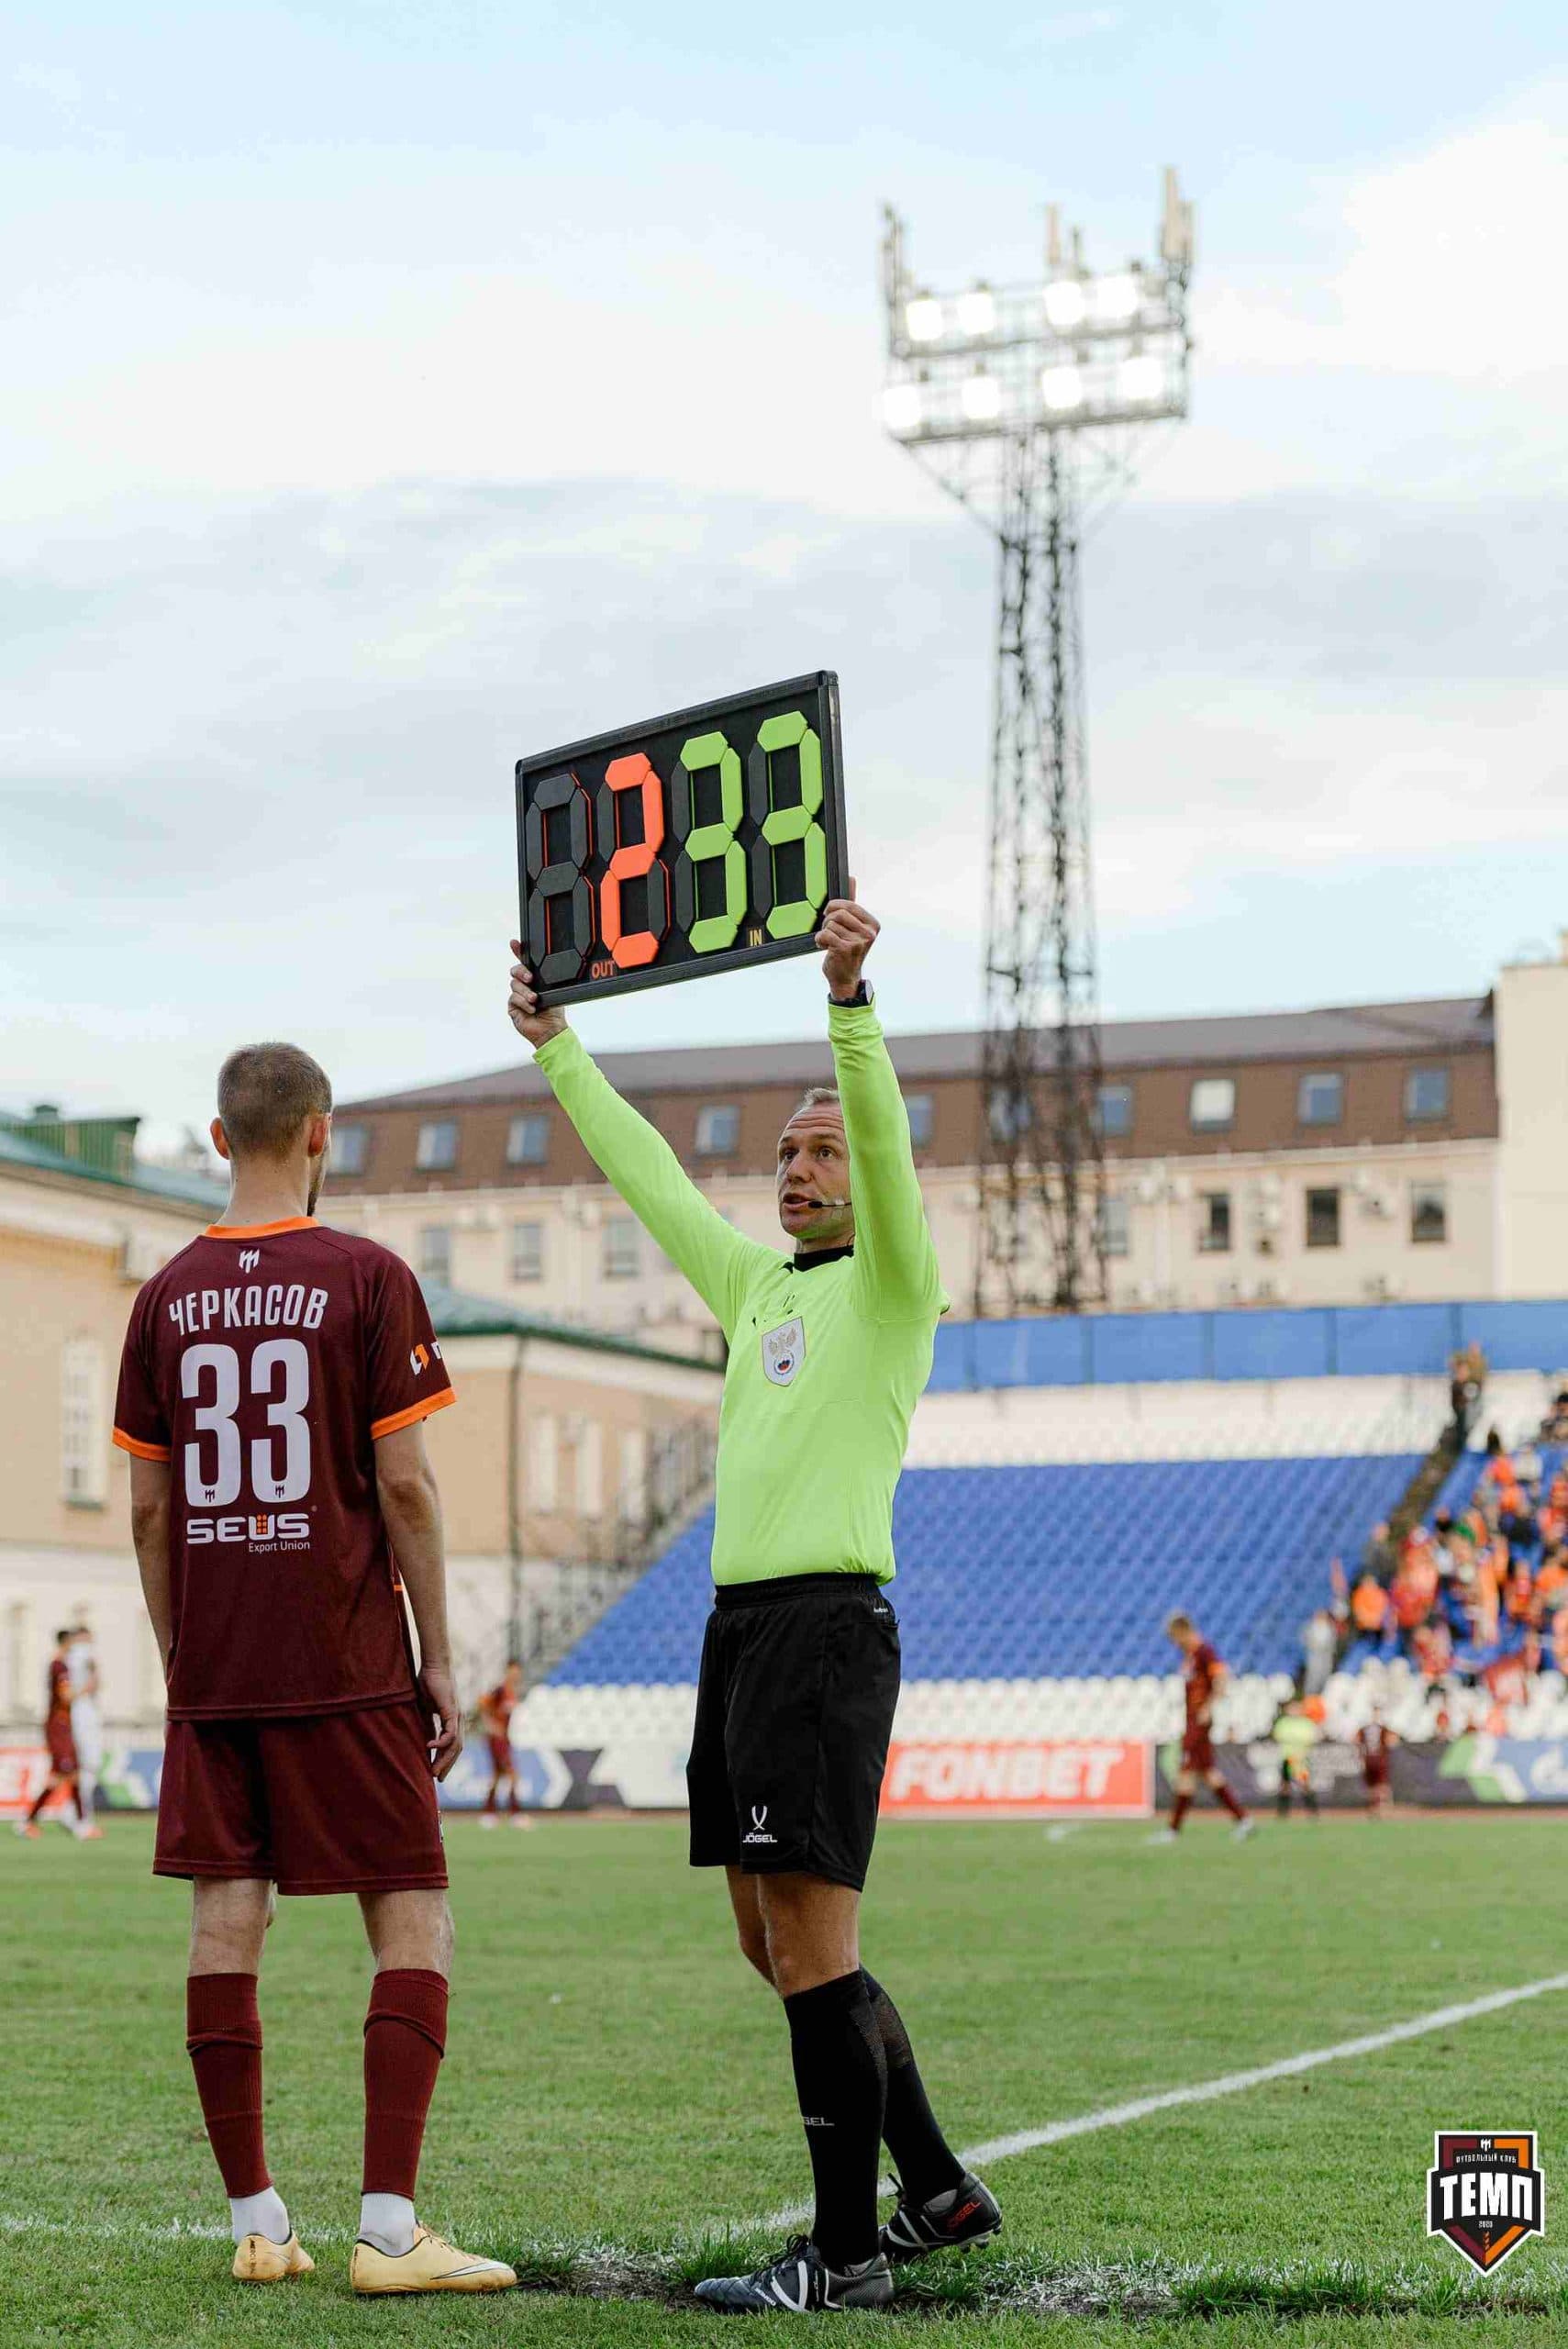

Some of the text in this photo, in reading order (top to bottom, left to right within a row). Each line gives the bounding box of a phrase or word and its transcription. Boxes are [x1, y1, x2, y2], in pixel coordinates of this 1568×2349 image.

[680, 710, 828, 953] 33
[749, 927, 763, 946] IN
[591, 961, 616, 979] OUT
[168, 1284, 328, 1336] ЧЕРКАСОВ
[181, 1339, 311, 1507] 33
[186, 1513, 310, 1544] SEUS
[248, 1541, 310, 1553] Export Union
[890, 1746, 1122, 1799] FONBET
